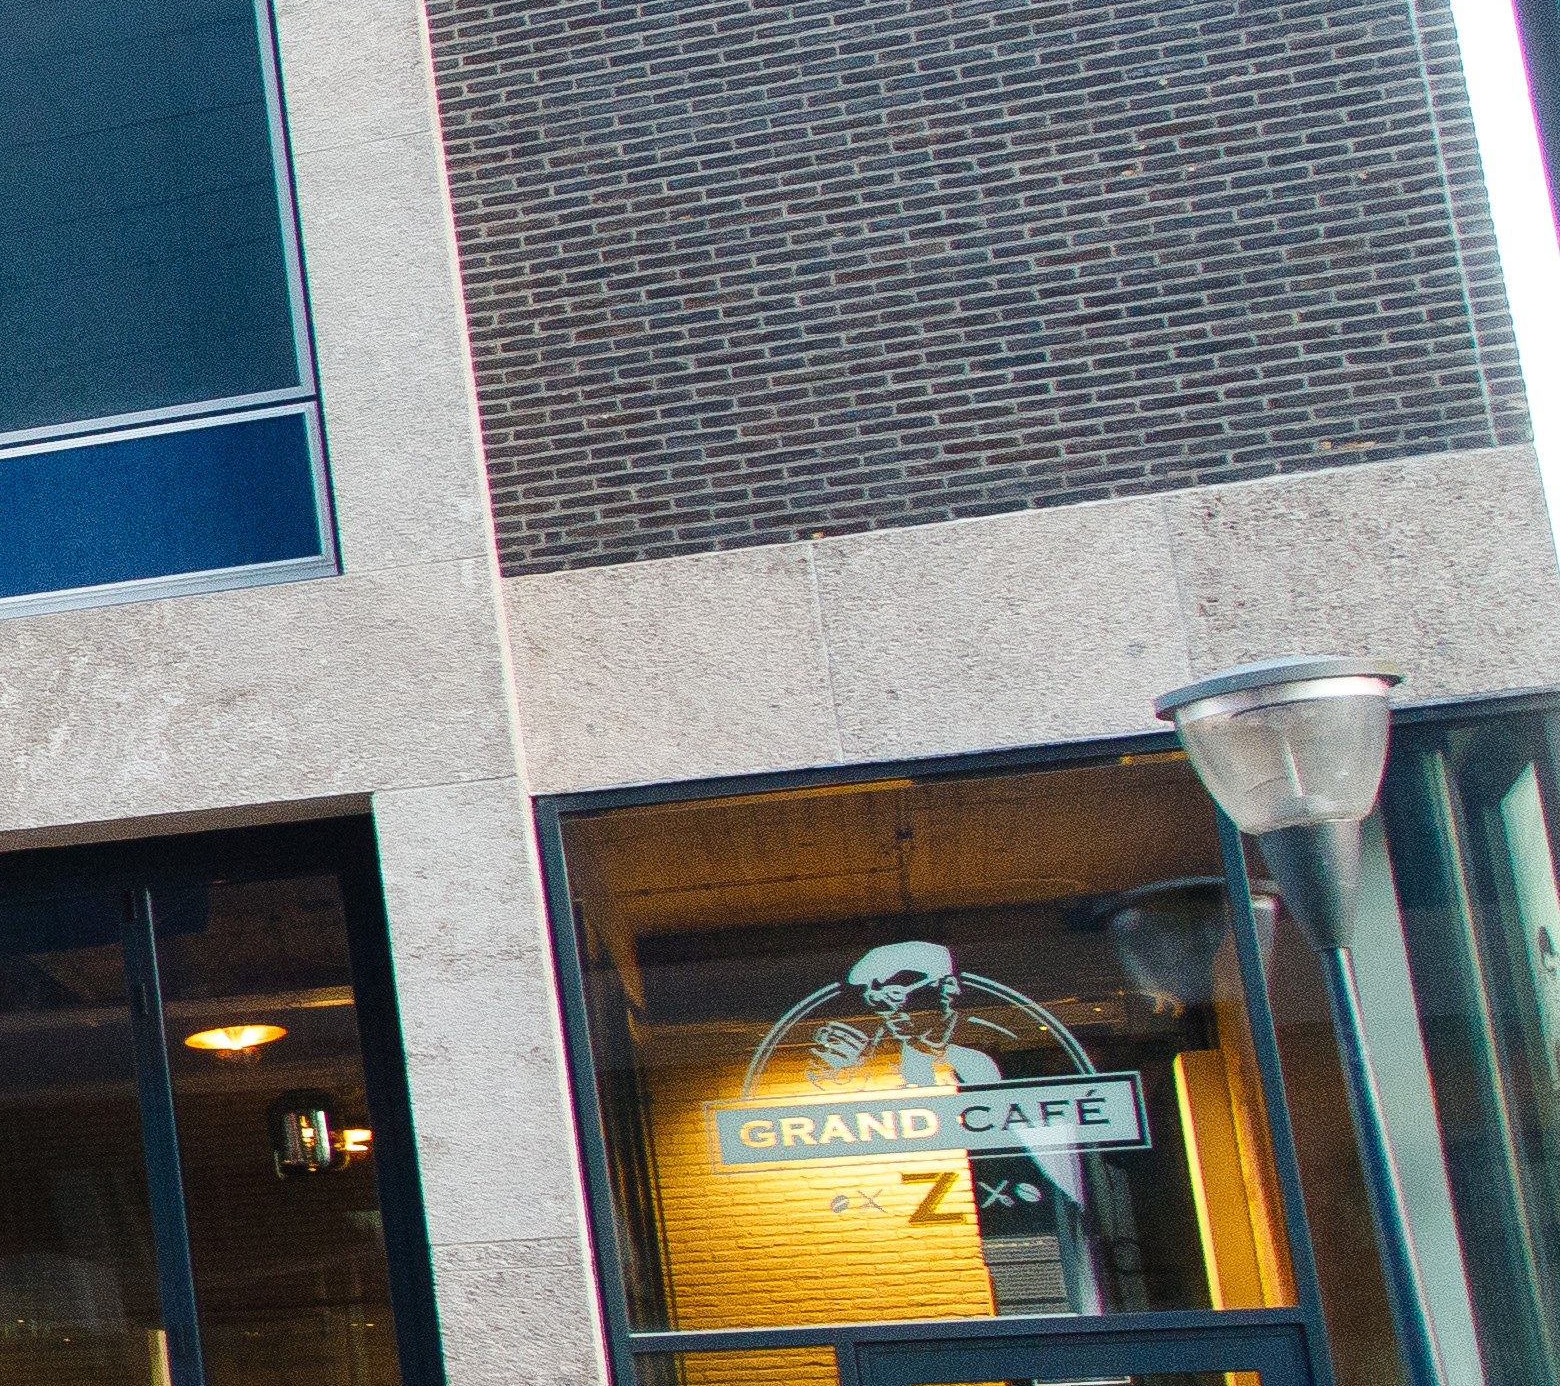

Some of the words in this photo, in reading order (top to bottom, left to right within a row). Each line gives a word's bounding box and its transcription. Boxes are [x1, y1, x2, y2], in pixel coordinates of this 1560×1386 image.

[740, 1109, 938, 1149] GRAND
[960, 1090, 1111, 1133] CAFÉ
[901, 1171, 968, 1226] Z
